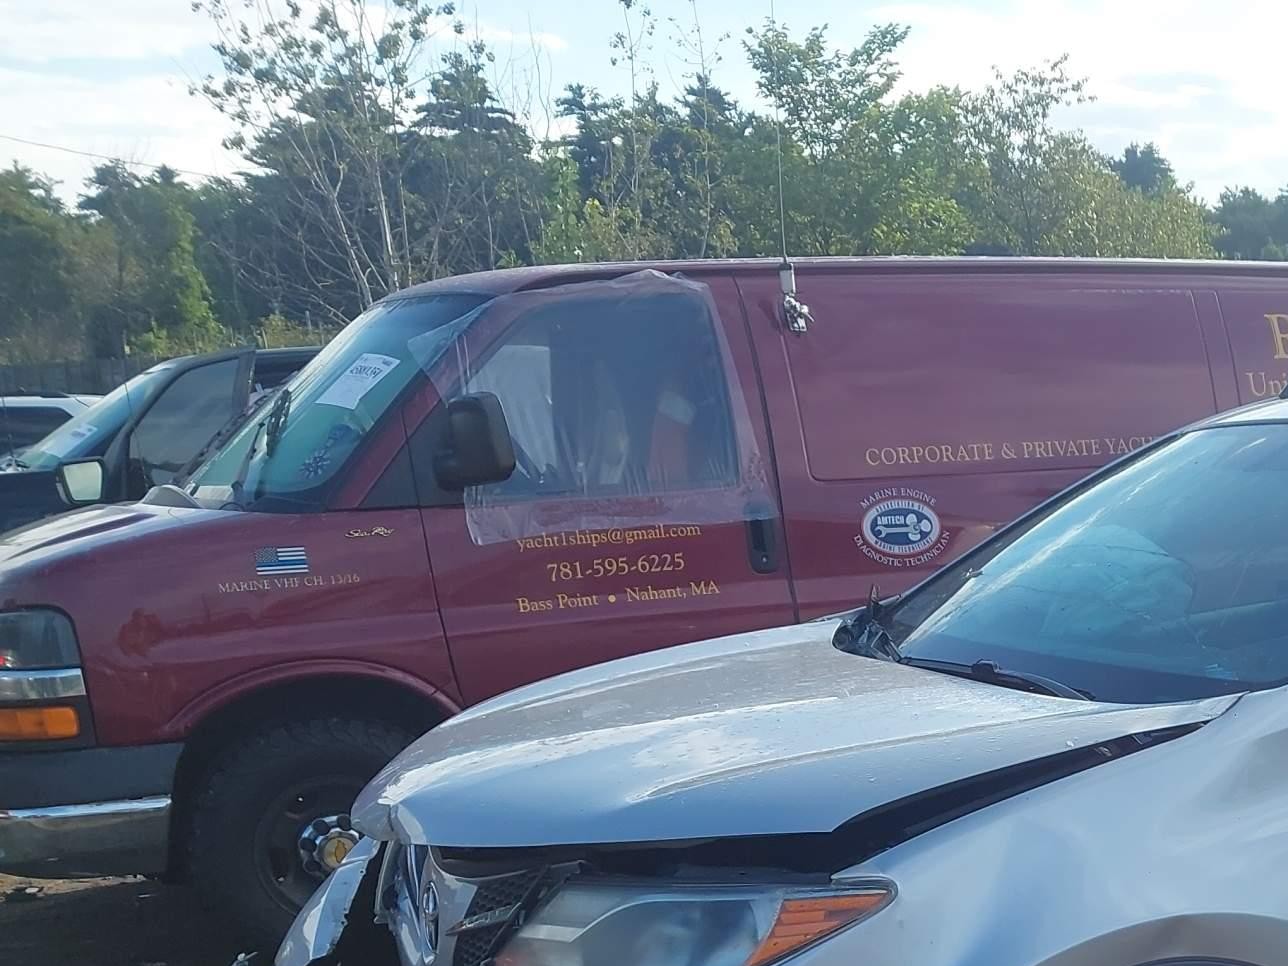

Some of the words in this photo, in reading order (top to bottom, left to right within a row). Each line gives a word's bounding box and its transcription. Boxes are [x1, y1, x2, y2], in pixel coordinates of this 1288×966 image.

[865, 443, 993, 465] CORPORATE
[1001, 442, 1016, 459] &
[1022, 436, 1100, 458] PRIVATE
[860, 488, 897, 509] MARINE
[901, 487, 937, 506] ENGINE
[517, 523, 702, 552] yacht1ships@gmail.com
[854, 534, 903, 567] DIAGNOSTIC
[903, 530, 950, 567] TECHNICIAN
[547, 552, 685, 582] 781-595-6225
[218, 578, 271, 593] MARINE
[275, 576, 300, 590] VHF
[330, 573, 361, 585] 13/16
[517, 597, 553, 613] Bass
[556, 594, 600, 610] Point
[625, 583, 687, 603] Nahant,
[690, 579, 720, 596] MA
